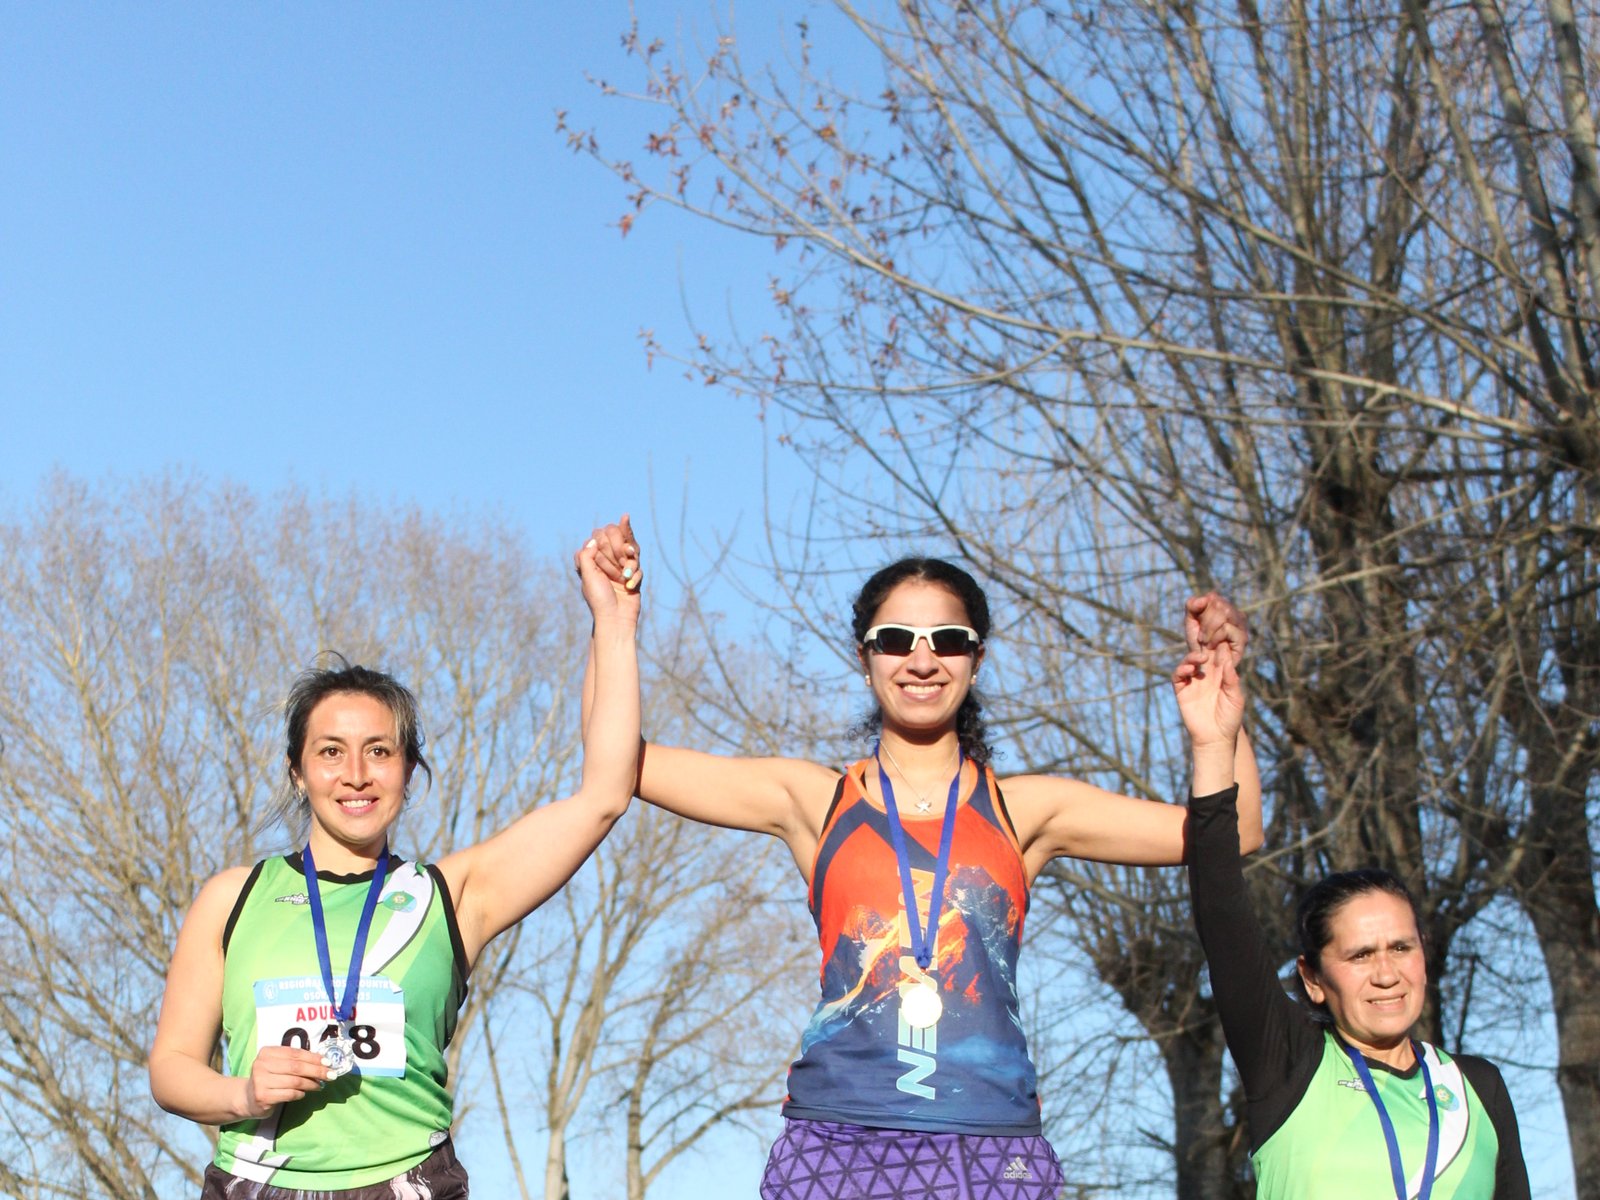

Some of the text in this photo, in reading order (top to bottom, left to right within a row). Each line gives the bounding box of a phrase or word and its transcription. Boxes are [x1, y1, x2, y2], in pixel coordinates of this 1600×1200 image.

[359, 979, 394, 990] OUNTR
[303, 990, 340, 1001] OSOO
[296, 1005, 357, 1022] ADULO
[1003, 1170, 1033, 1180] adidas
